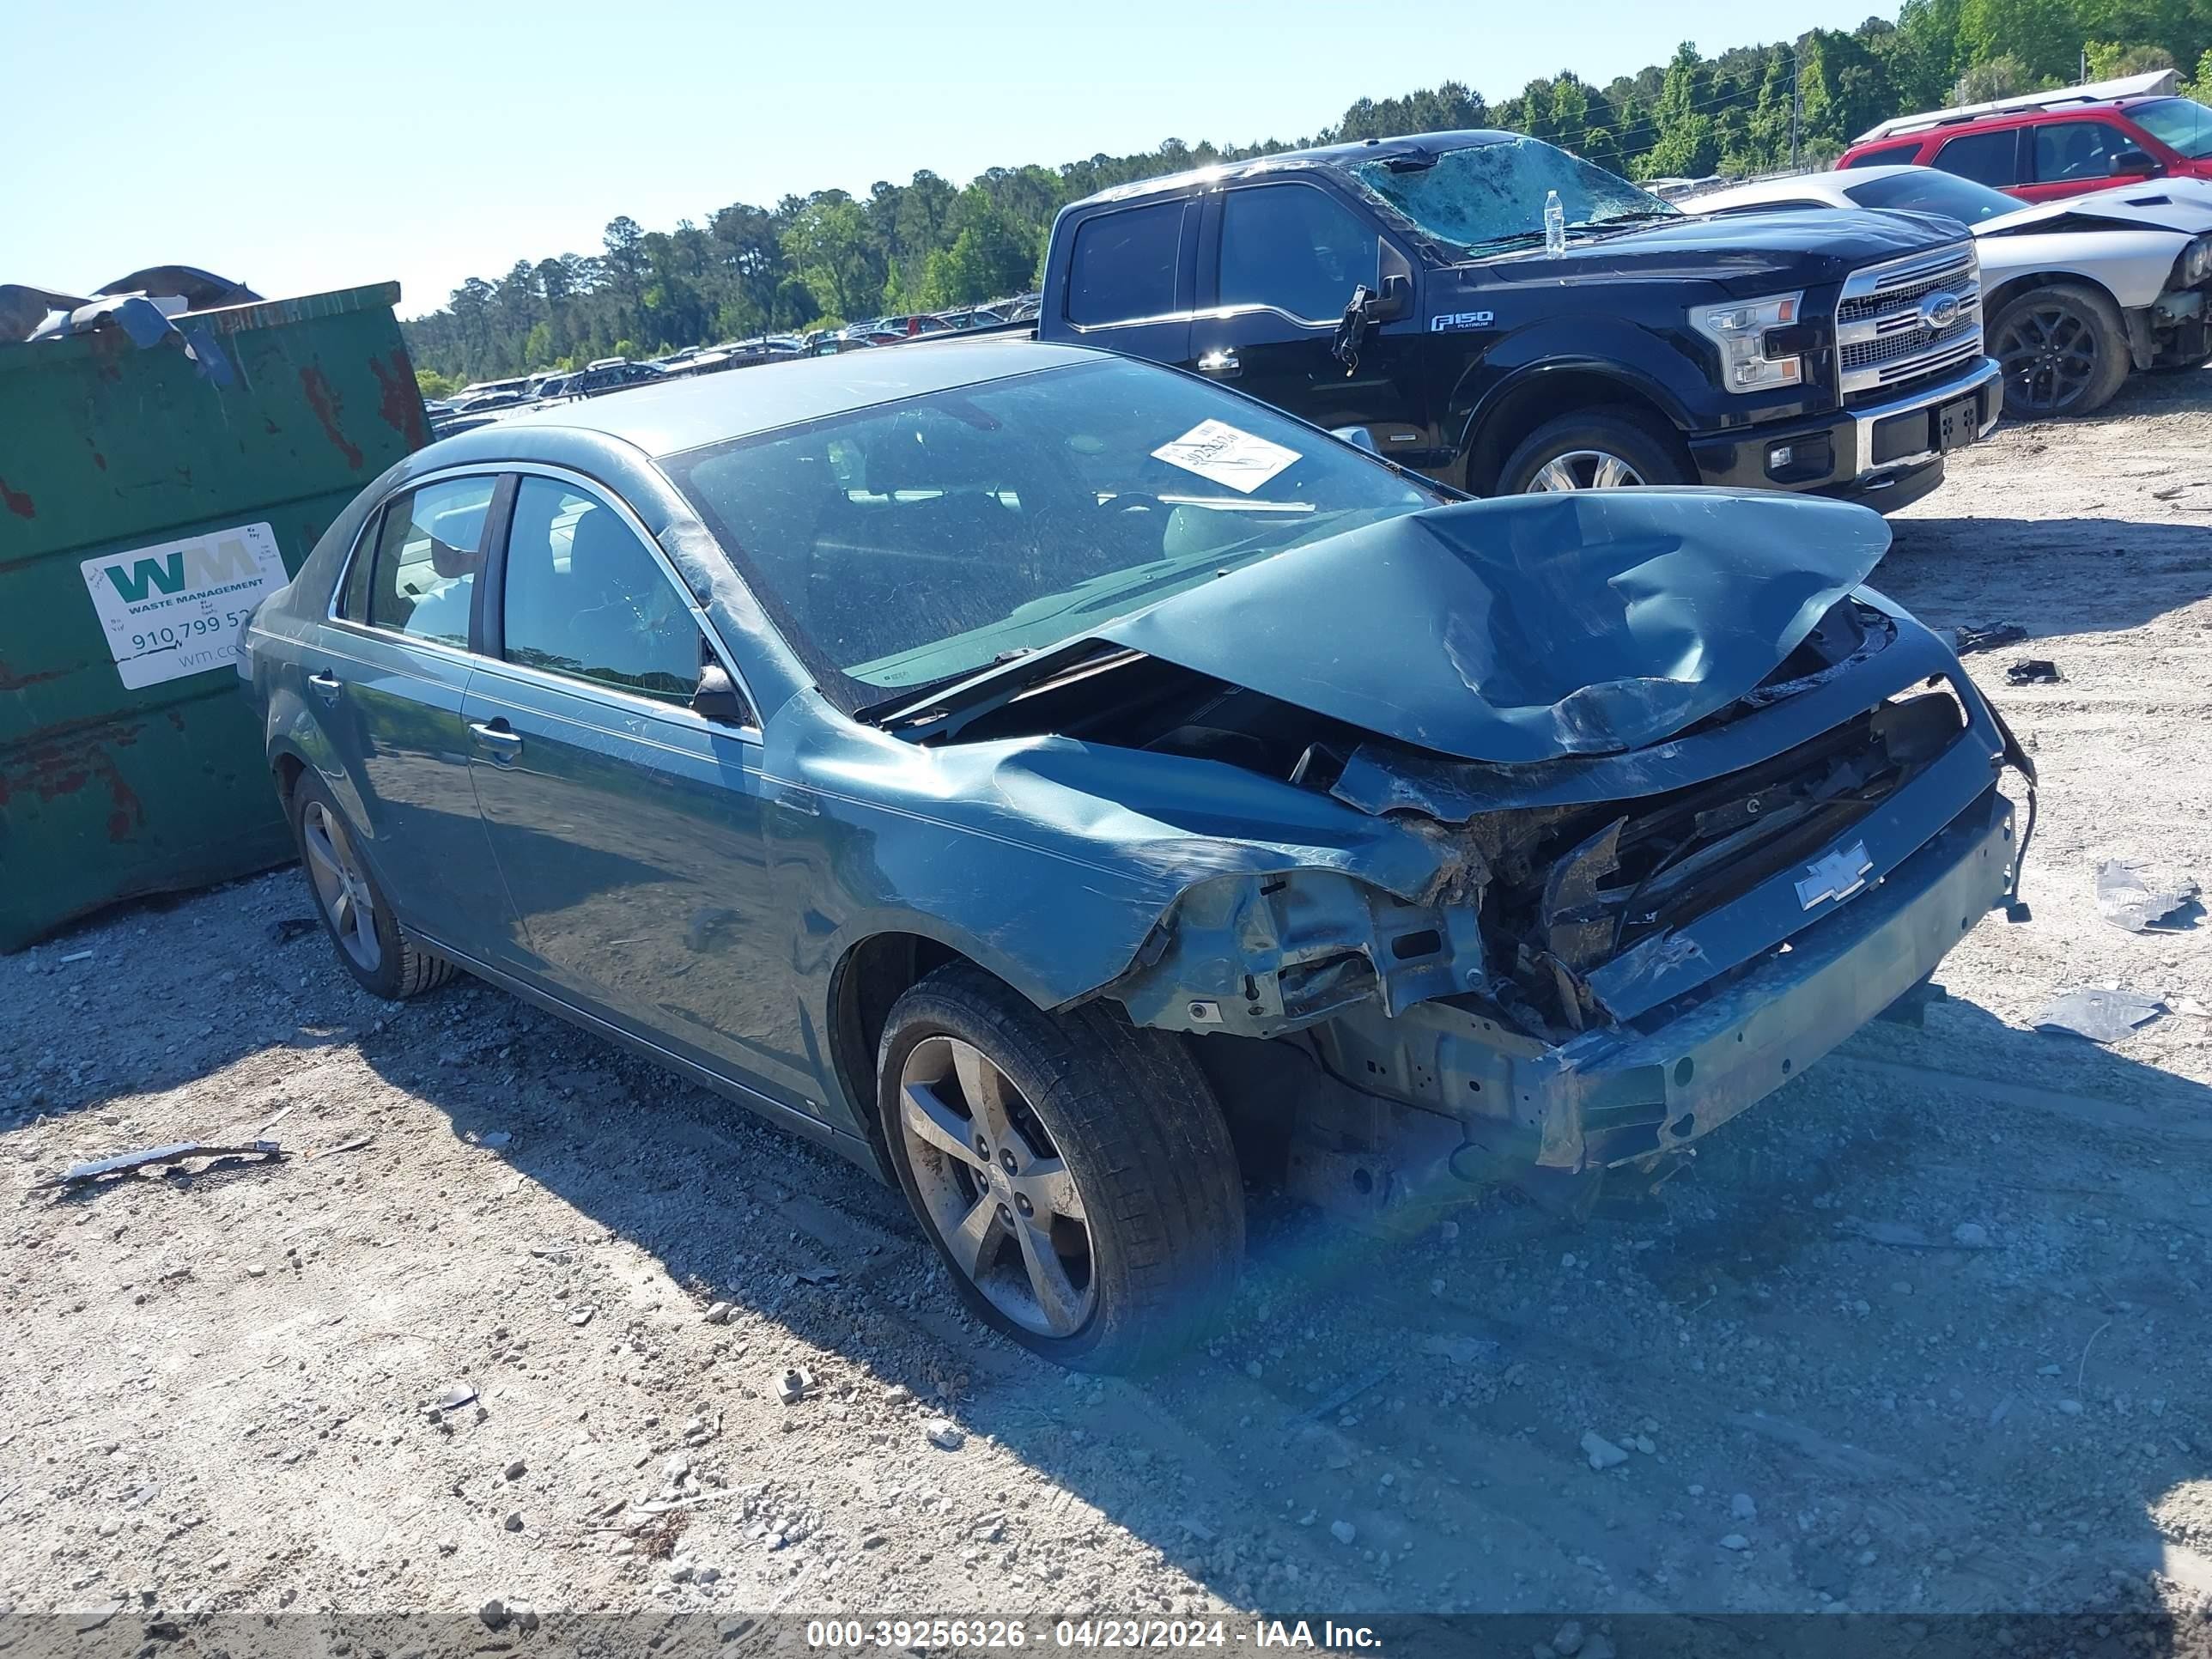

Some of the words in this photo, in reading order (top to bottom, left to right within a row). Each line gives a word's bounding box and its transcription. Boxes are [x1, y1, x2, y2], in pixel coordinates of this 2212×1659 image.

[129, 599, 173, 615] WASTE
[176, 578, 264, 605] MANAGEMENT
[131, 628, 174, 650] 910
[179, 617, 221, 639] 799
